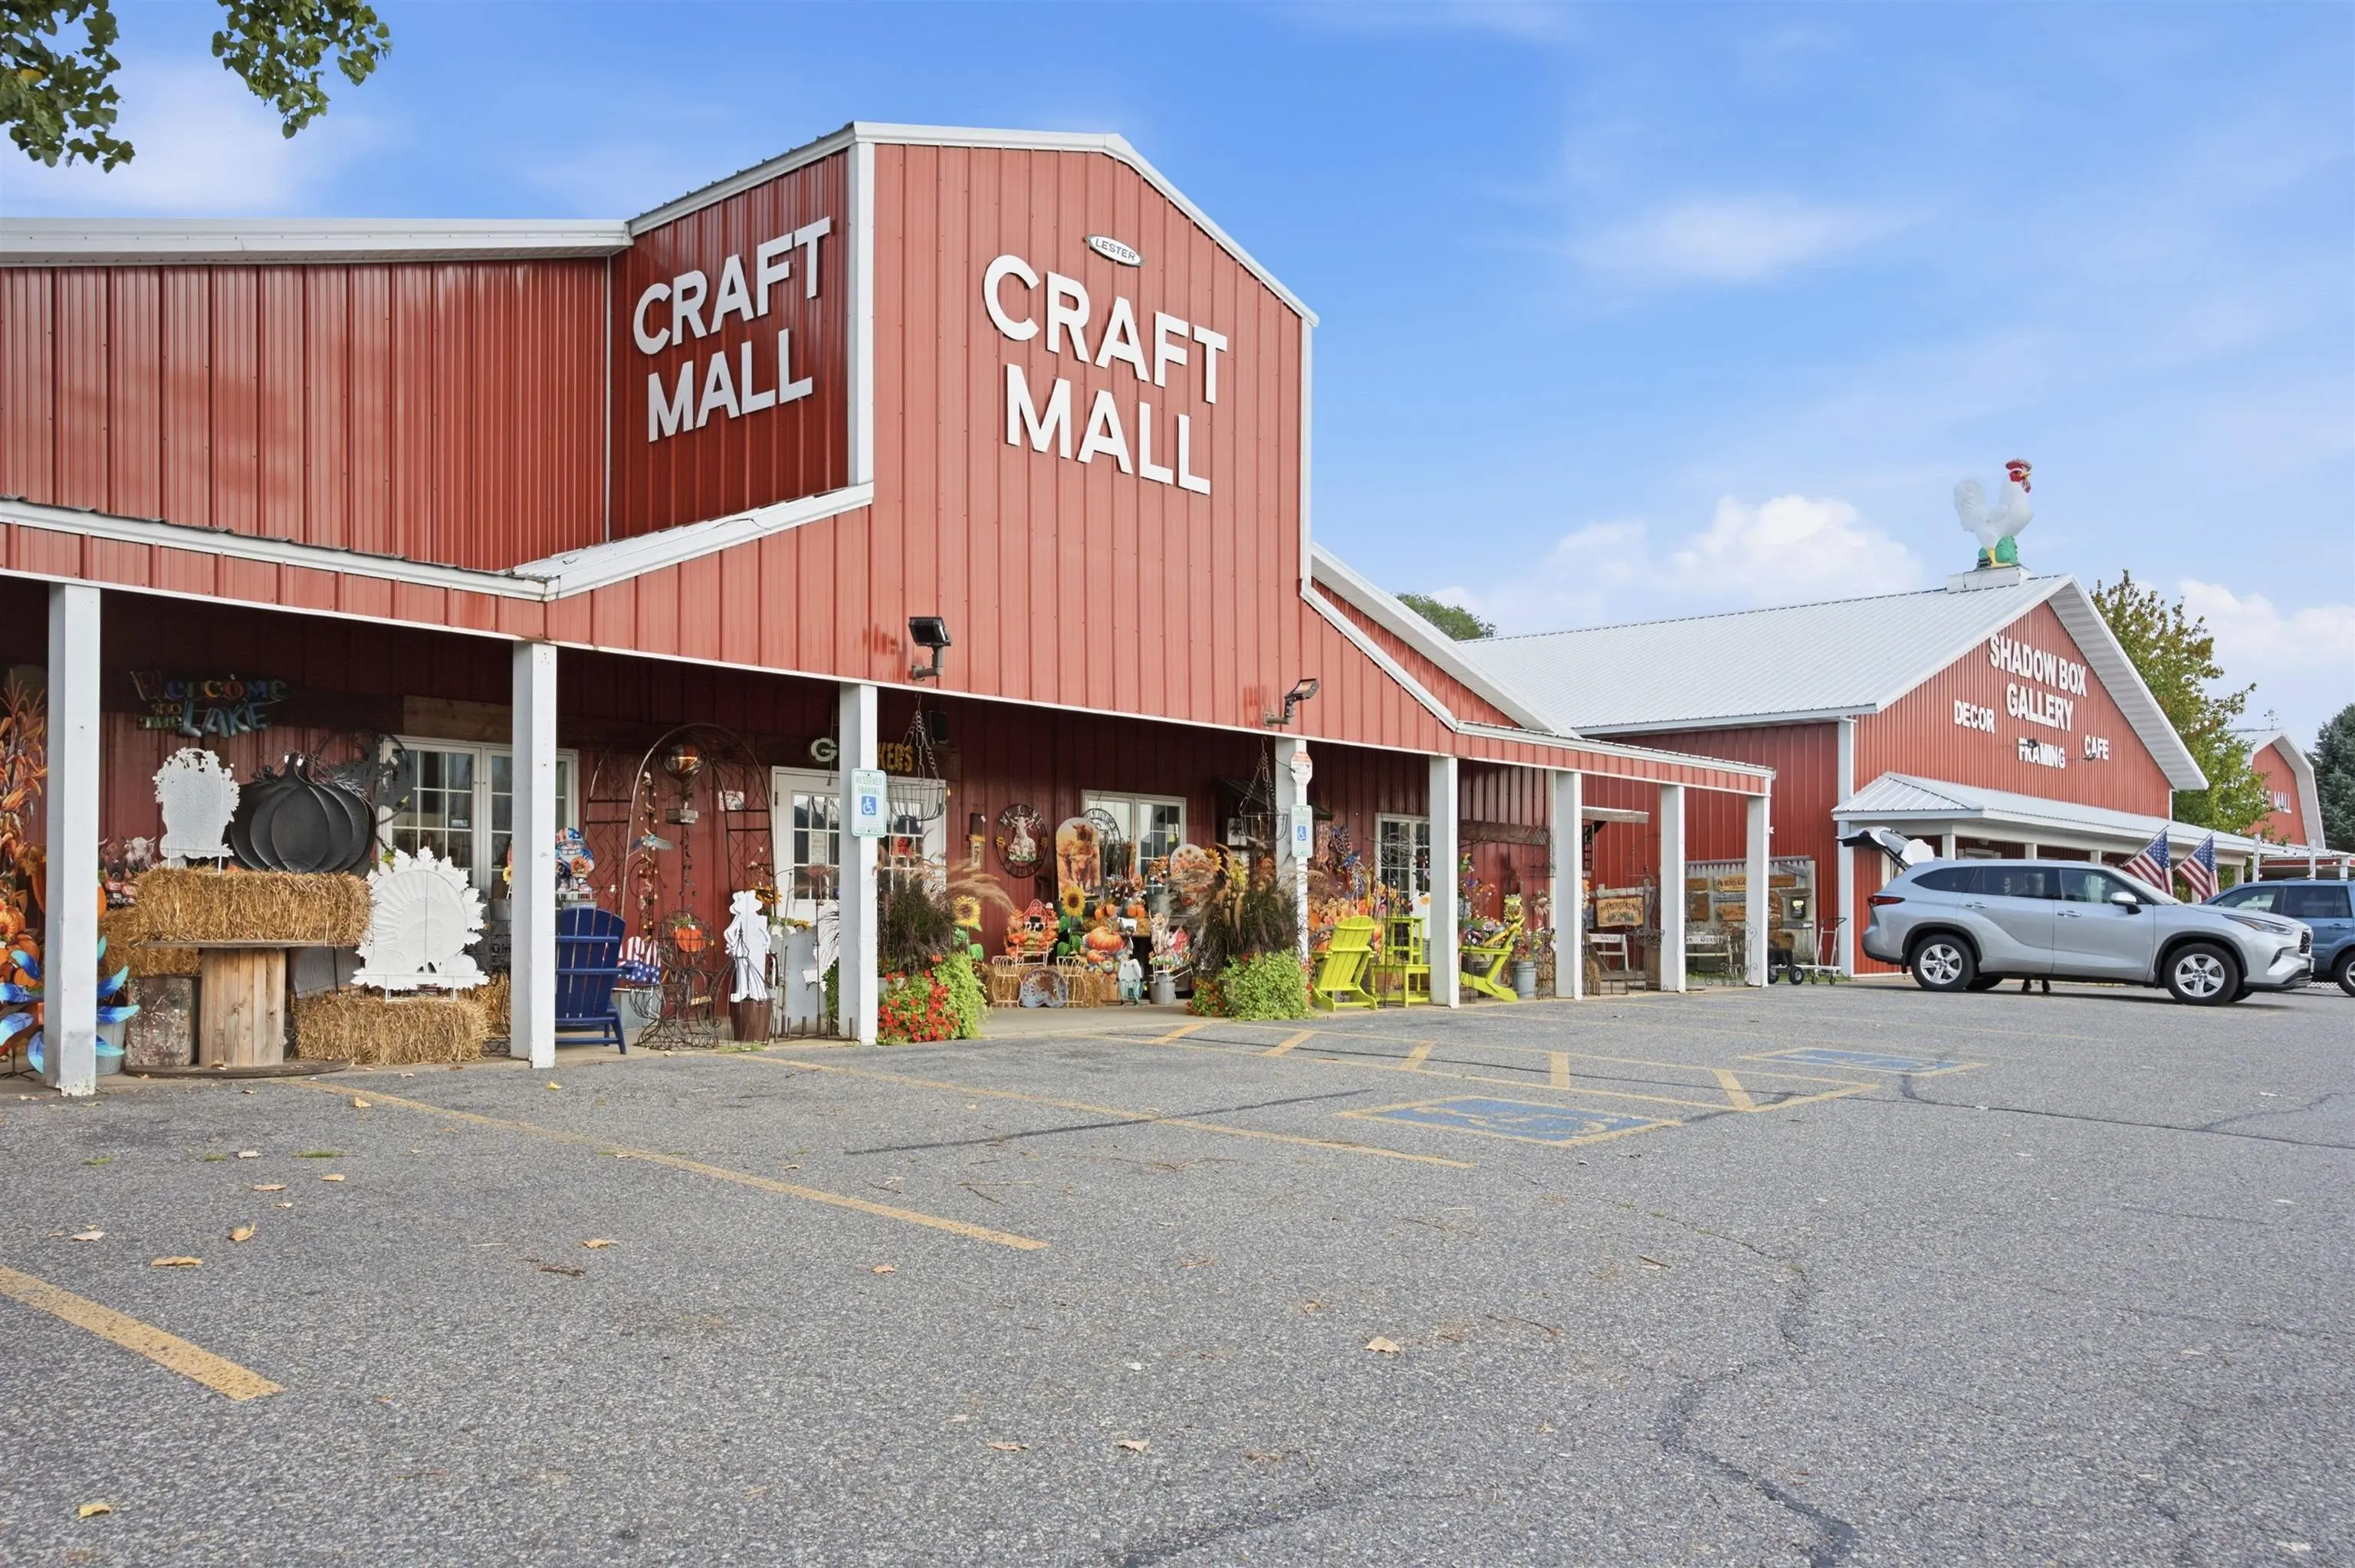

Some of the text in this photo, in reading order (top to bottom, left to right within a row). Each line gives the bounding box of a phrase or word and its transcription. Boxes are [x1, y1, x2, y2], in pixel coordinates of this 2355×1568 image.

[1095, 238, 1136, 261] LESTER
[632, 215, 831, 356] CRAFT
[982, 254, 1228, 405] CRAFT
[648, 327, 813, 443] MALL
[1004, 362, 1211, 496] MALL
[1987, 633, 2087, 697] SHADOW BOX
[179, 697, 268, 739] LAKE
[1953, 699, 1995, 734] DECOR
[2005, 682, 2074, 732] GALLERY
[2016, 736, 2066, 769] FRAMING
[2084, 733, 2110, 761] CAFE
[2273, 789, 2292, 815] MALL
